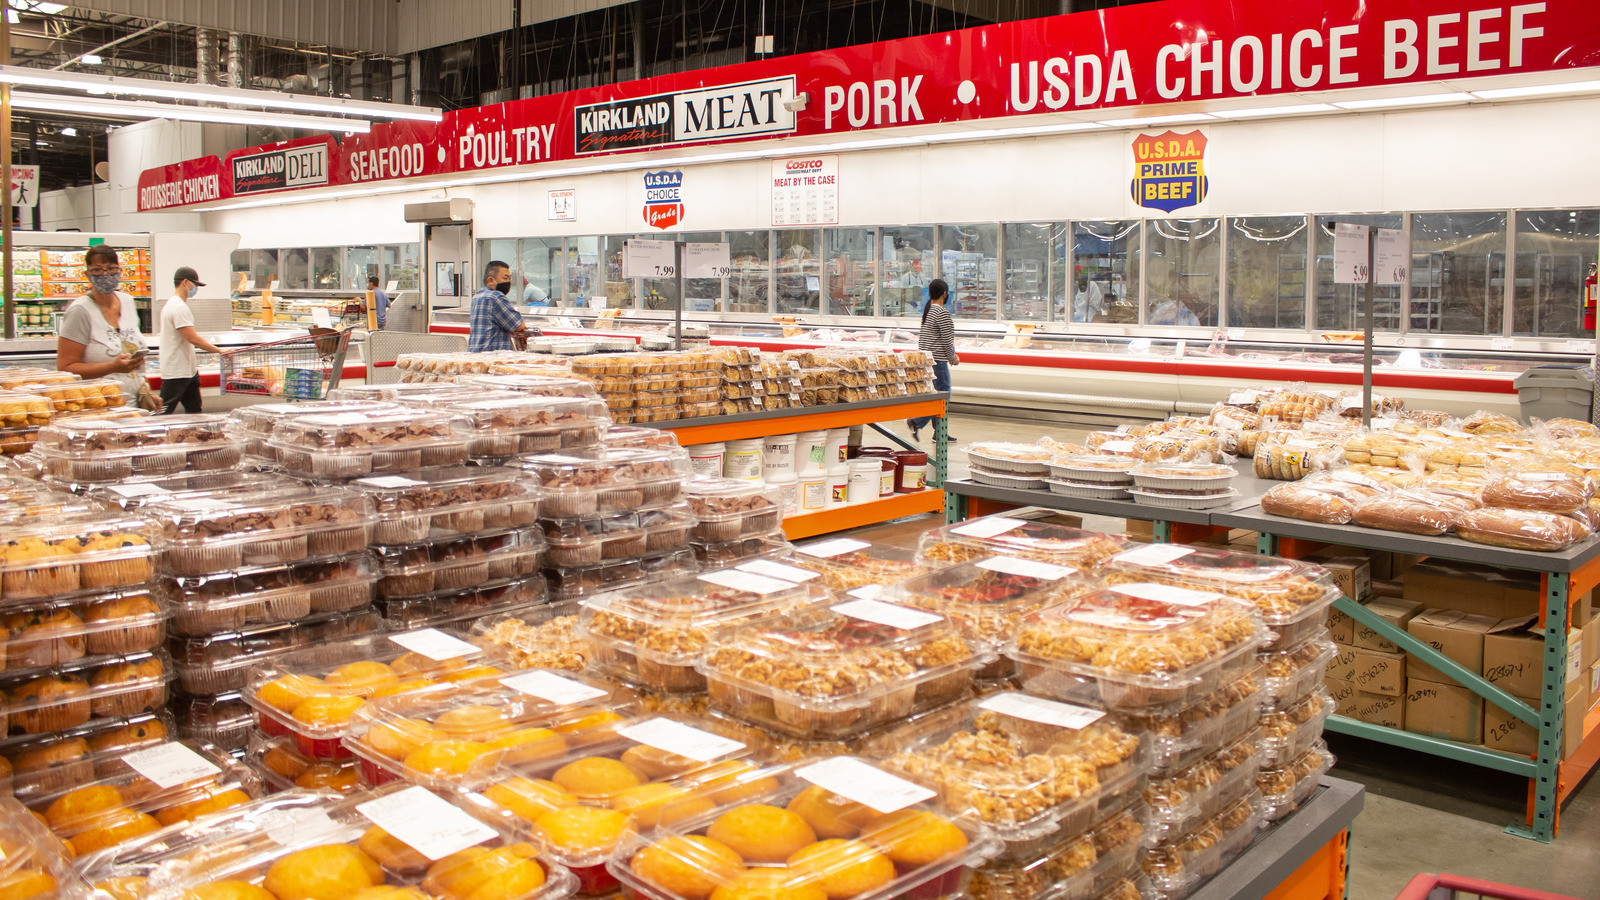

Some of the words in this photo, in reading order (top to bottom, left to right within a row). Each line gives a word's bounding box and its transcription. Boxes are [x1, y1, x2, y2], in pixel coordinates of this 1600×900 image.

[1010, 49, 1137, 112] USDA
[1155, 24, 1360, 100] CHOICE
[1383, 1, 1547, 80] BEEF
[683, 88, 783, 133] MEAT
[824, 74, 925, 130] PORK
[581, 101, 670, 134] KIRKLAND
[459, 123, 556, 168] POULTRY
[580, 129, 669, 151] Signature
[1138, 139, 1201, 160] U.S.D.A.
[236, 155, 285, 178] KIRKLAND
[288, 151, 323, 181] DELI
[350, 143, 424, 182] SEAFOOD
[1141, 161, 1198, 177] PRIME
[236, 177, 284, 192] Signature
[646, 174, 681, 186] U.S.D.A.
[774, 178, 792, 187] MEAT
[793, 177, 802, 187] BY
[804, 176, 816, 186] THE
[817, 175, 836, 185] CASE
[141, 181, 183, 209] ROTISSERIE
[183, 174, 220, 204] CHICKEN
[647, 188, 679, 200] CHOICE
[1145, 181, 1193, 200] BEEF
[651, 207, 677, 226] Grade
[655, 265, 674, 276] 7.99
[711, 267, 730, 276] 7.99
[1353, 265, 1368, 281] 5.99
[1393, 267, 1406, 282] 6.99
